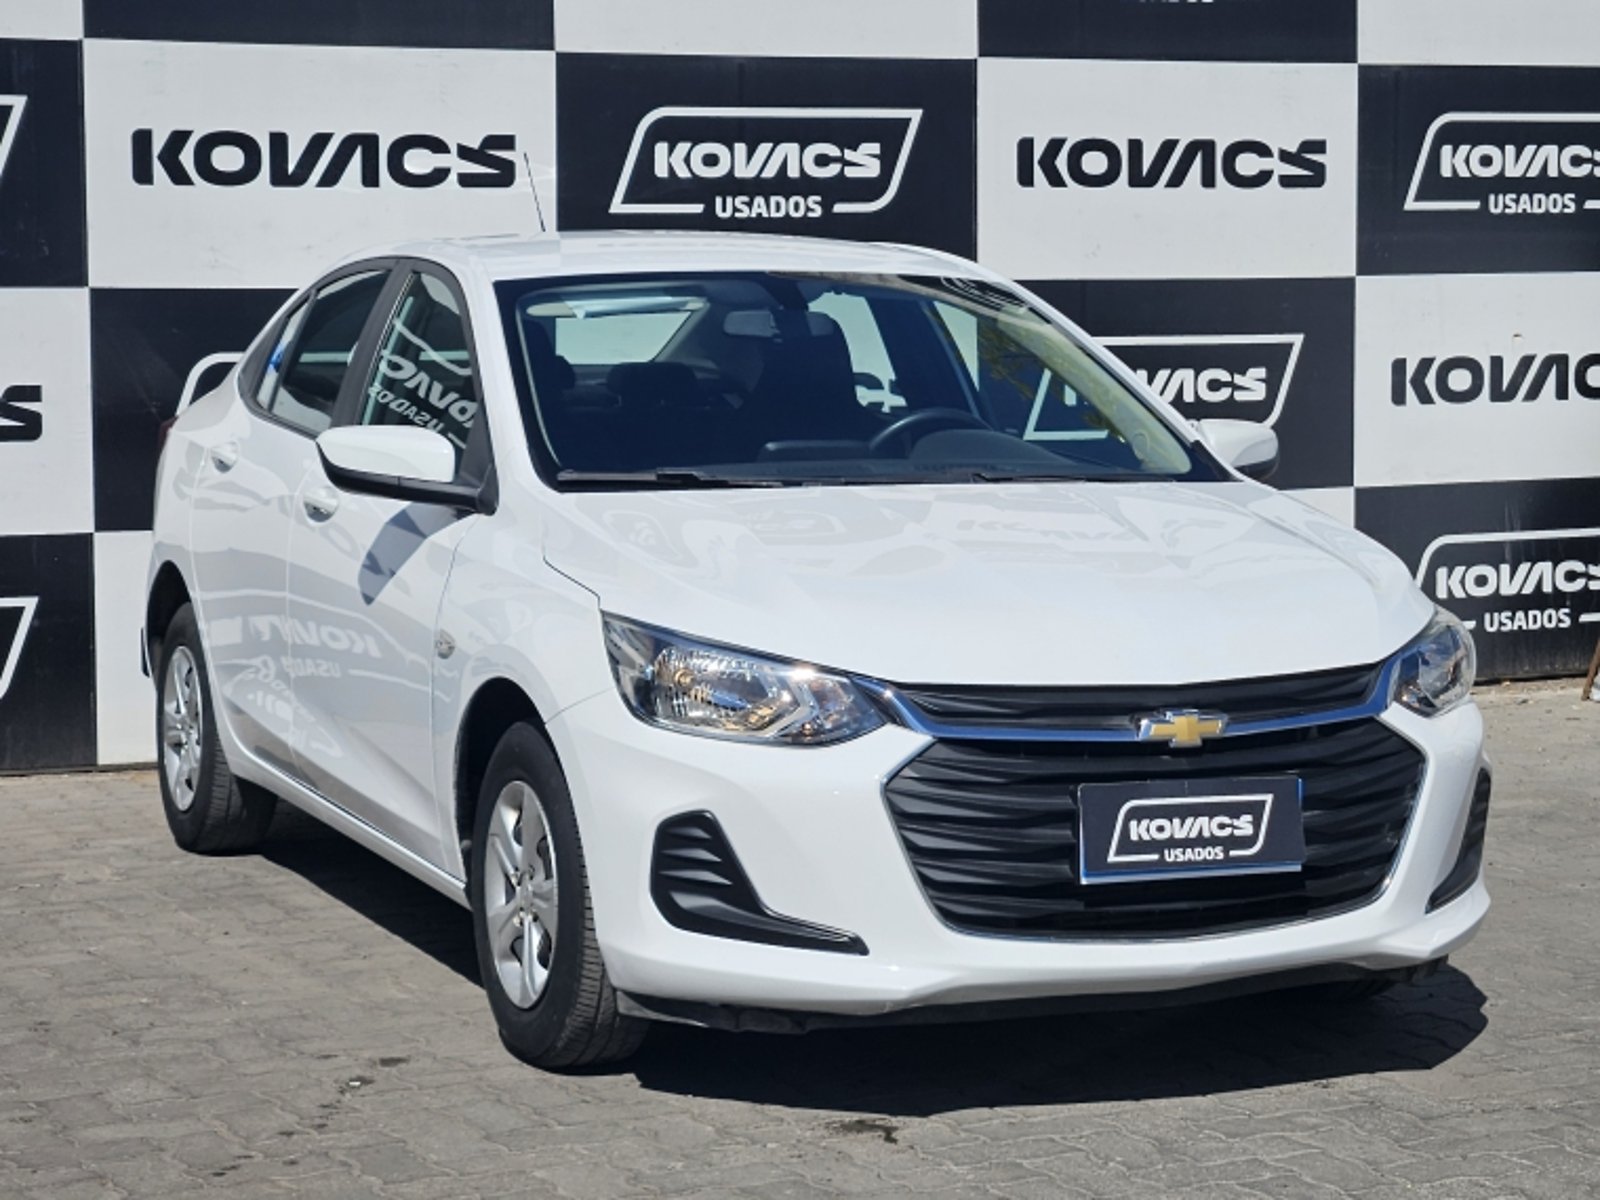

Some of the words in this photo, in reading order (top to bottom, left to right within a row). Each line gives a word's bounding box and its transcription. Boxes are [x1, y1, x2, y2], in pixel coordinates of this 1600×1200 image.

[131, 128, 517, 188] KOVACS
[653, 141, 881, 178] KOVACS
[1016, 136, 1328, 189] KOVACS
[1439, 144, 1600, 178] KOVAC
[714, 195, 823, 218] USADOS
[1488, 193, 1577, 214] USADOS
[1484, 607, 1572, 632] USADOS
[1129, 814, 1254, 841] KOVACS
[1164, 846, 1224, 862] USADOS
